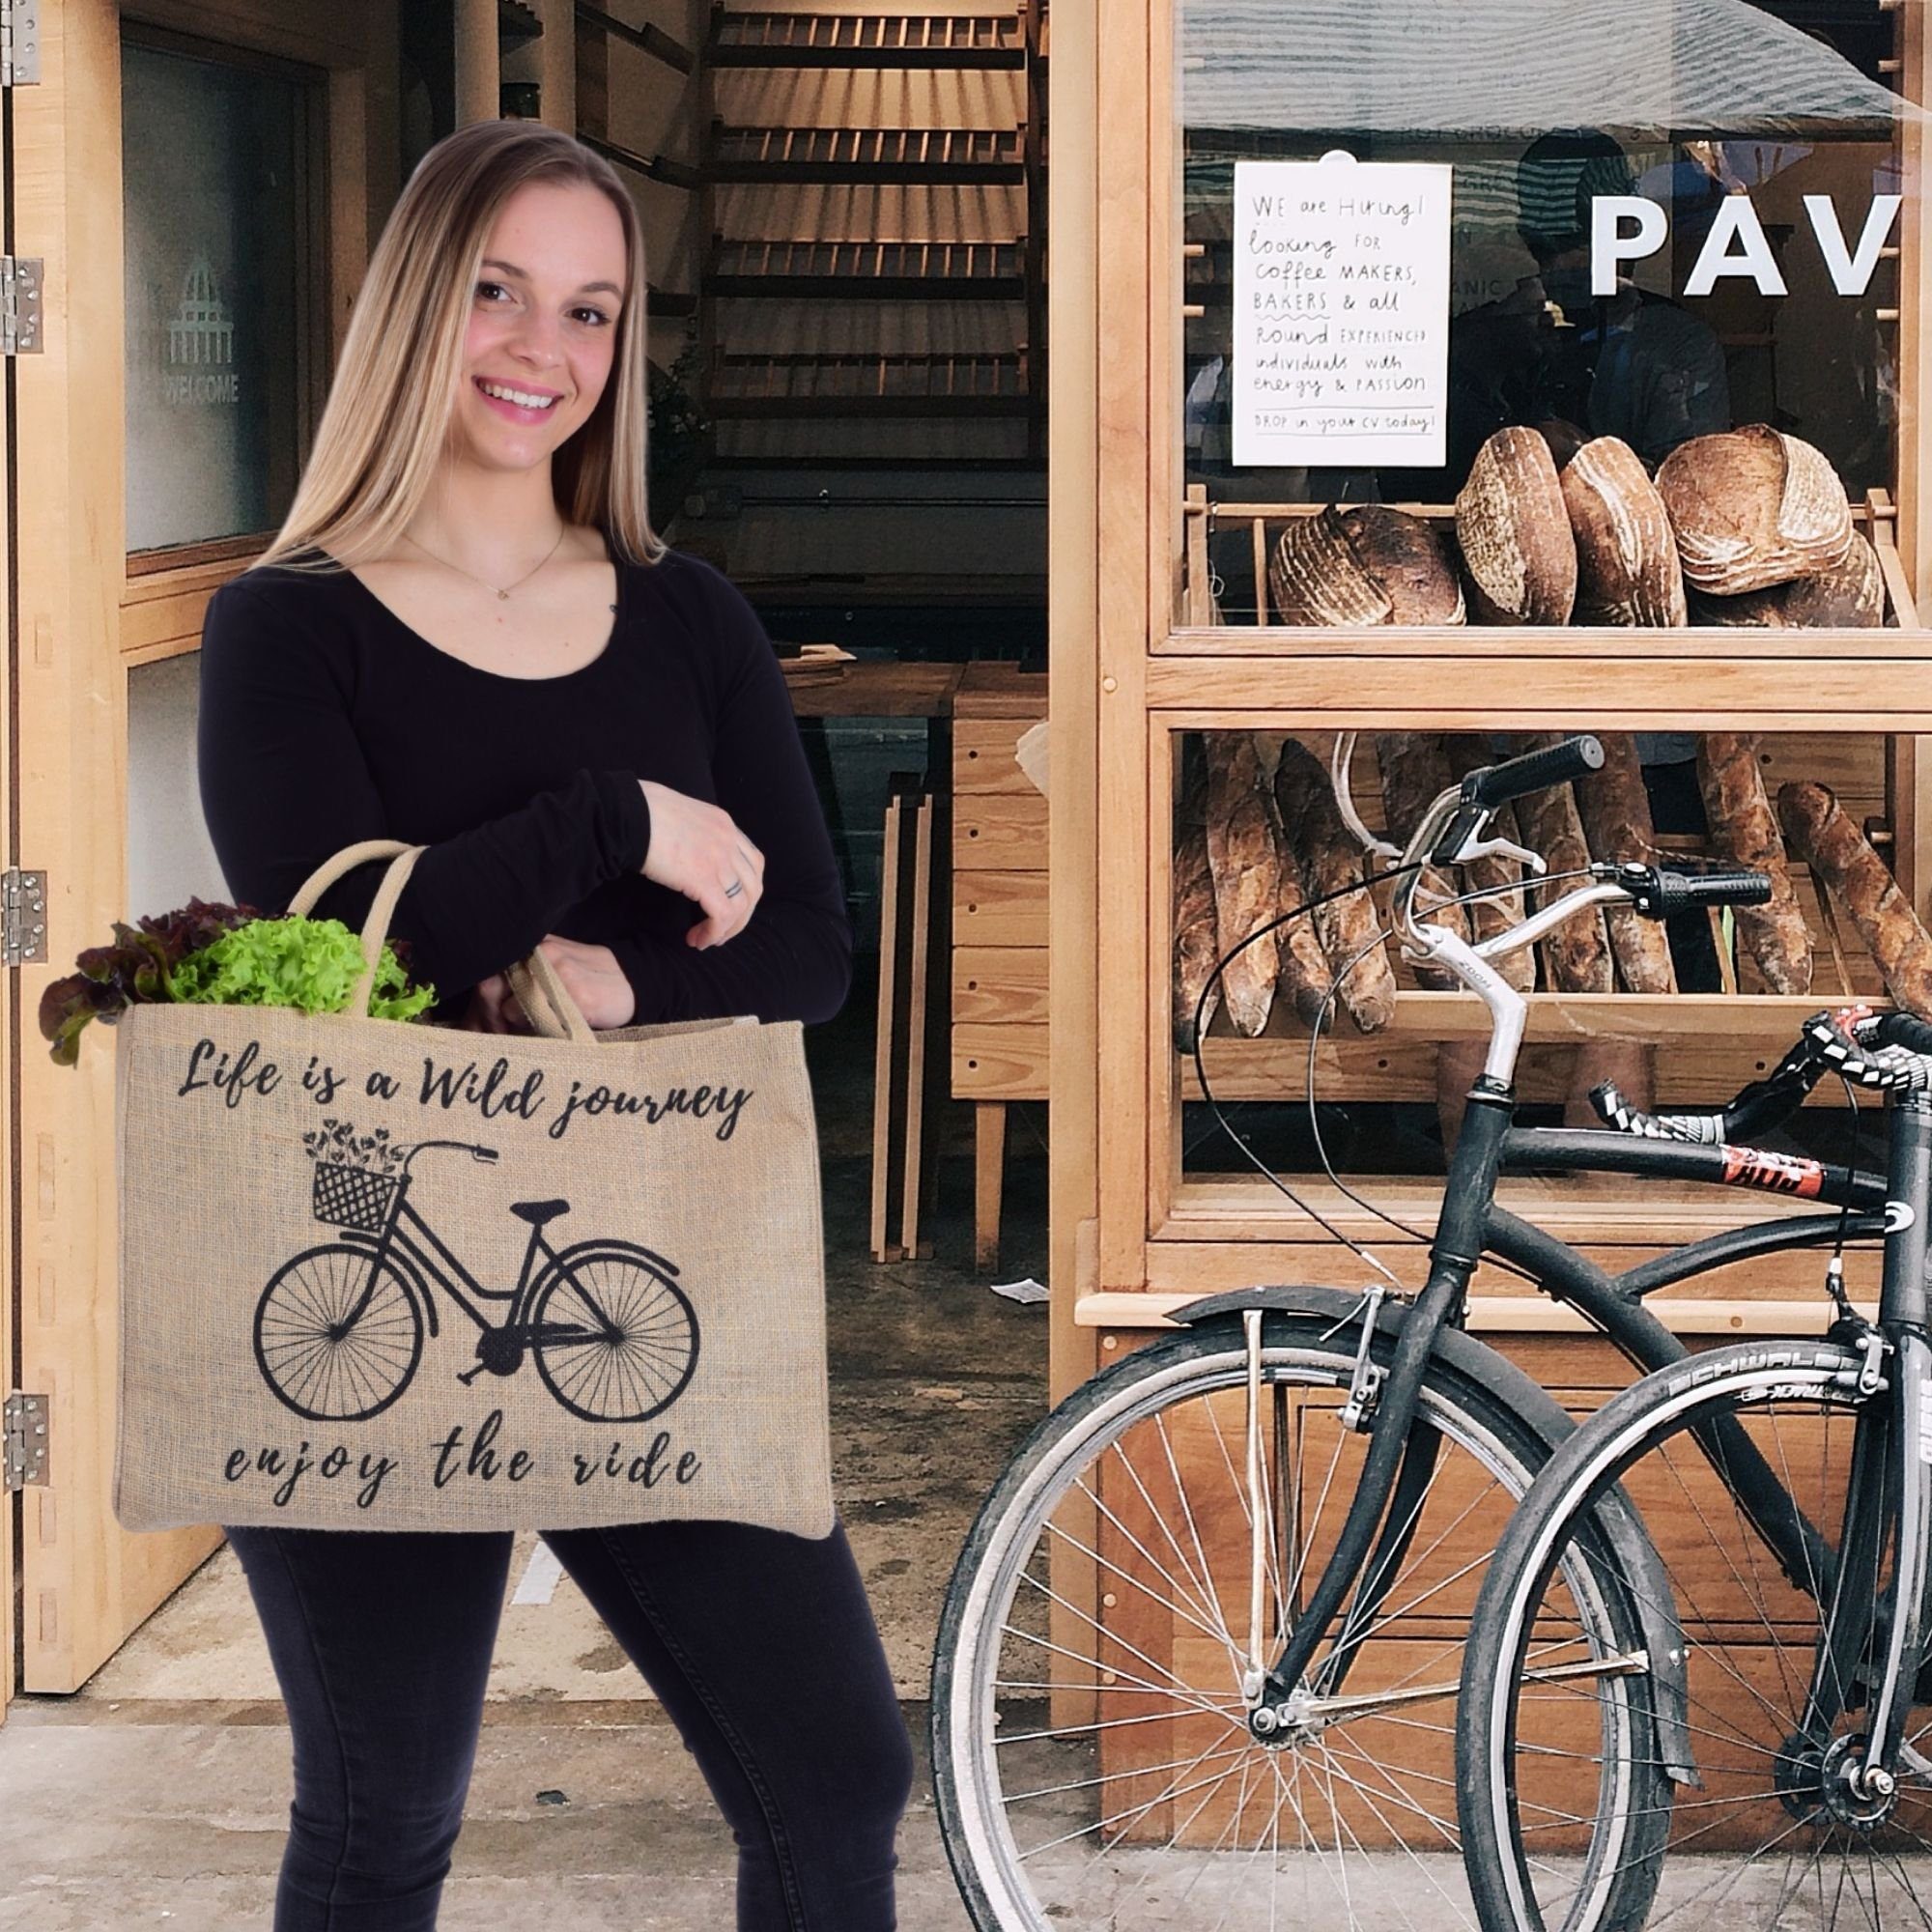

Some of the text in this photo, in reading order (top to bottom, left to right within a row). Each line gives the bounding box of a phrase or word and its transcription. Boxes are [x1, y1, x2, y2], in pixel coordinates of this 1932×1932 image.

[1252, 195, 1424, 226] WE are Hiring!
[1249, 229, 1381, 260] looking FOR
[1591, 194, 1903, 297] PAV
[1339, 264, 1417, 286] MAKERS,
[1253, 291, 1400, 312] BAKERS & all
[1256, 352, 1402, 372] individuals with
[163, 374, 240, 403] WELCOME
[1253, 377, 1323, 398] energy
[1335, 378, 1348, 393] &
[1255, 413, 1435, 436] DROP in your CV today!
[178, 1038, 754, 1141] Life is a Wild journey
[225, 1409, 702, 1508] enjoy the ride
